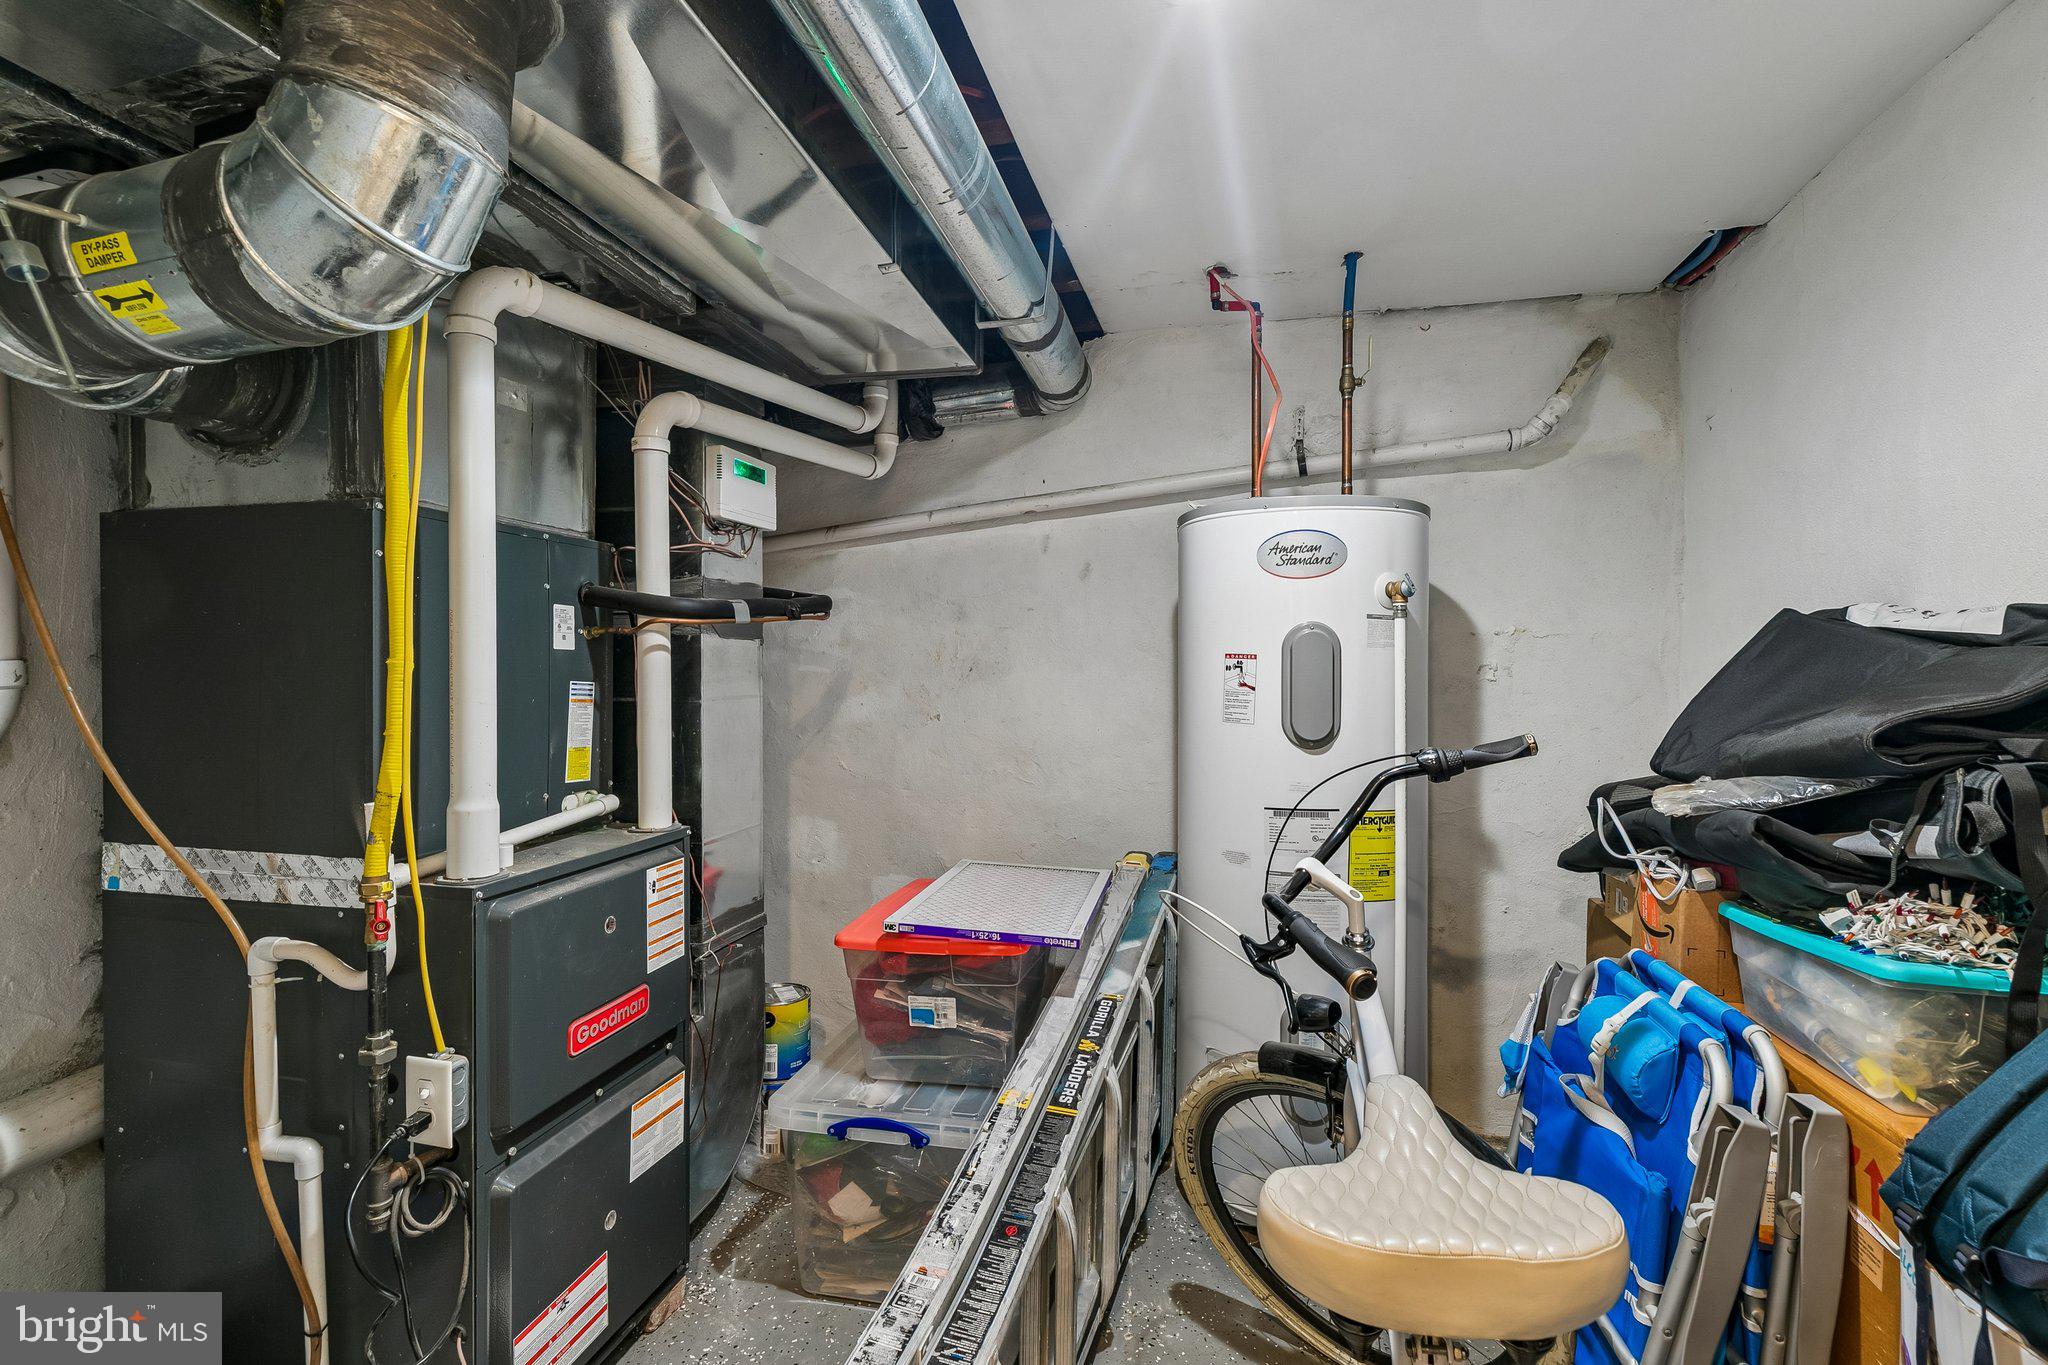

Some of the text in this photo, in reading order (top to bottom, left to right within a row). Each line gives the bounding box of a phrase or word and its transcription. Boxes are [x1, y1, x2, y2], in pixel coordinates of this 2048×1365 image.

[80, 237, 120, 256] BY-PASS
[85, 251, 127, 269] DAMPER
[1267, 541, 1322, 556] American
[1276, 552, 1335, 567] Standard
[884, 923, 897, 931] 3M
[1043, 937, 1078, 948] Filtrete
[576, 996, 645, 1044] Goodman
[1058, 999, 1113, 1104] GORILLA LADDERS
[1187, 1127, 1197, 1176] KENDA
